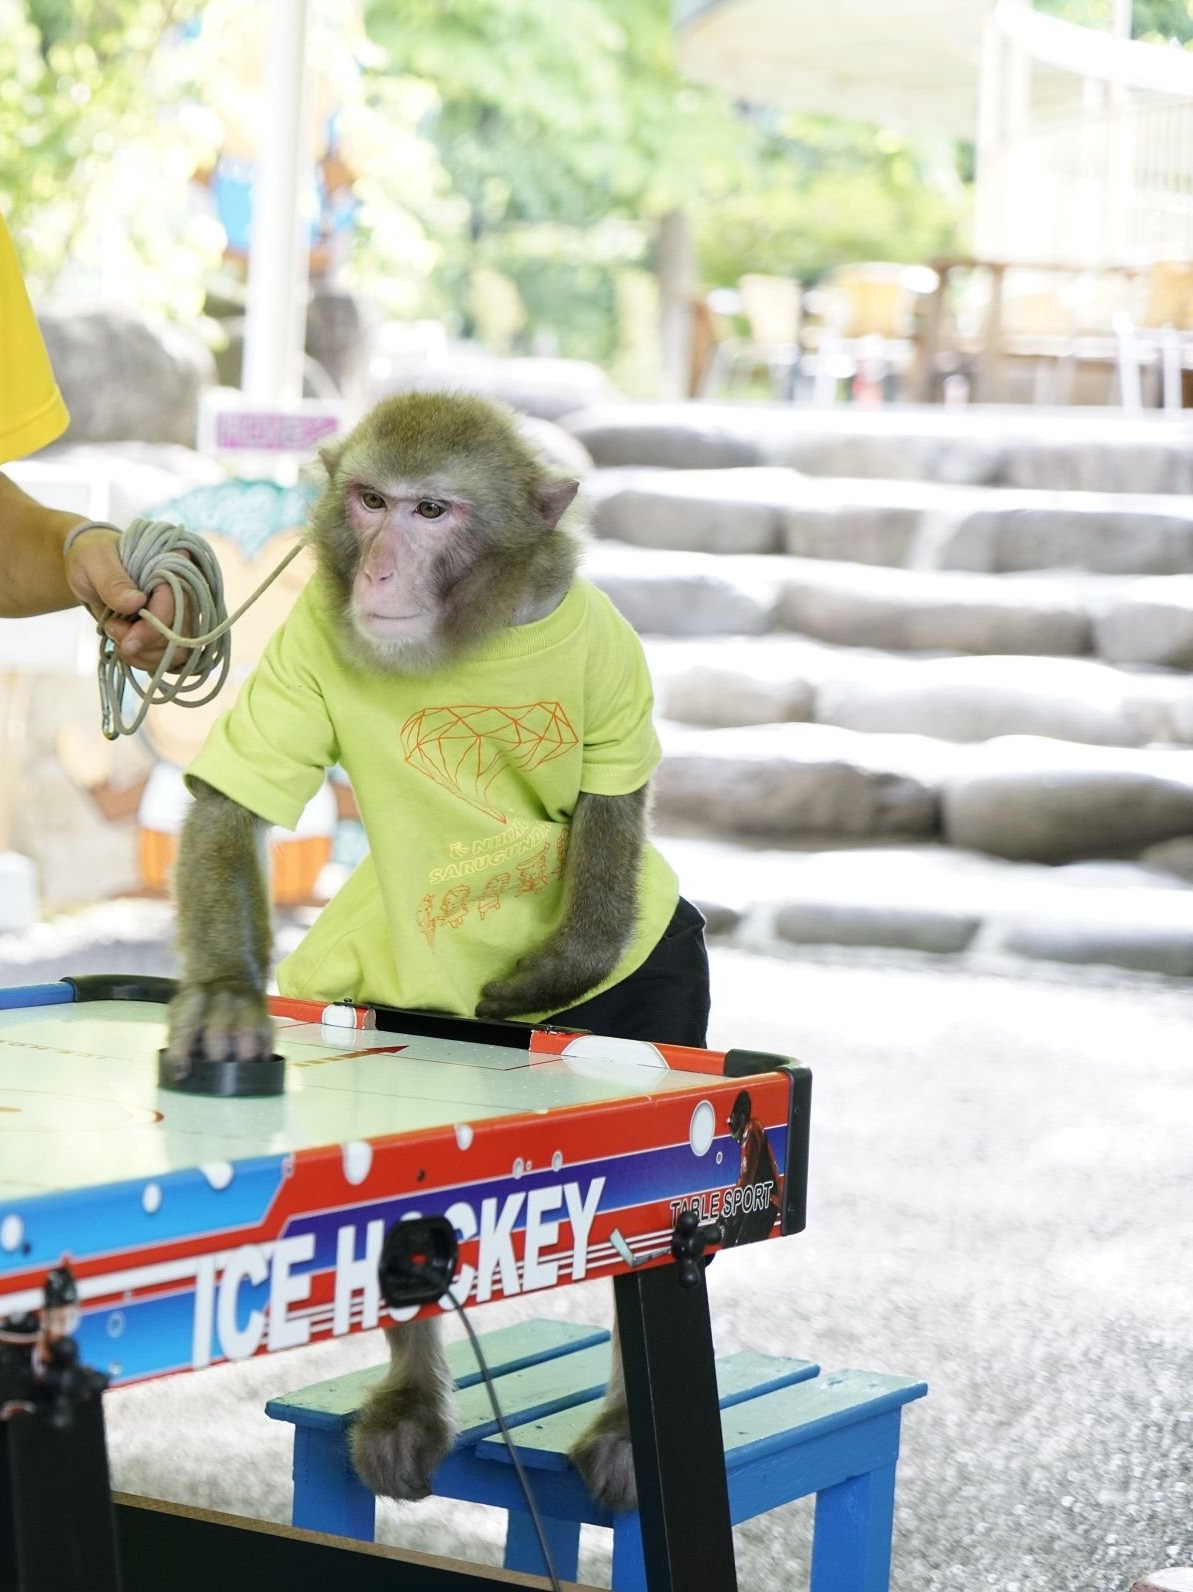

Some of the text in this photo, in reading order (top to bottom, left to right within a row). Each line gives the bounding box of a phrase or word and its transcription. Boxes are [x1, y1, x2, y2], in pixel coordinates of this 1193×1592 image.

[670, 1181, 774, 1229] TABLE SPORT
[192, 1176, 606, 1369] ICE HCKEY
